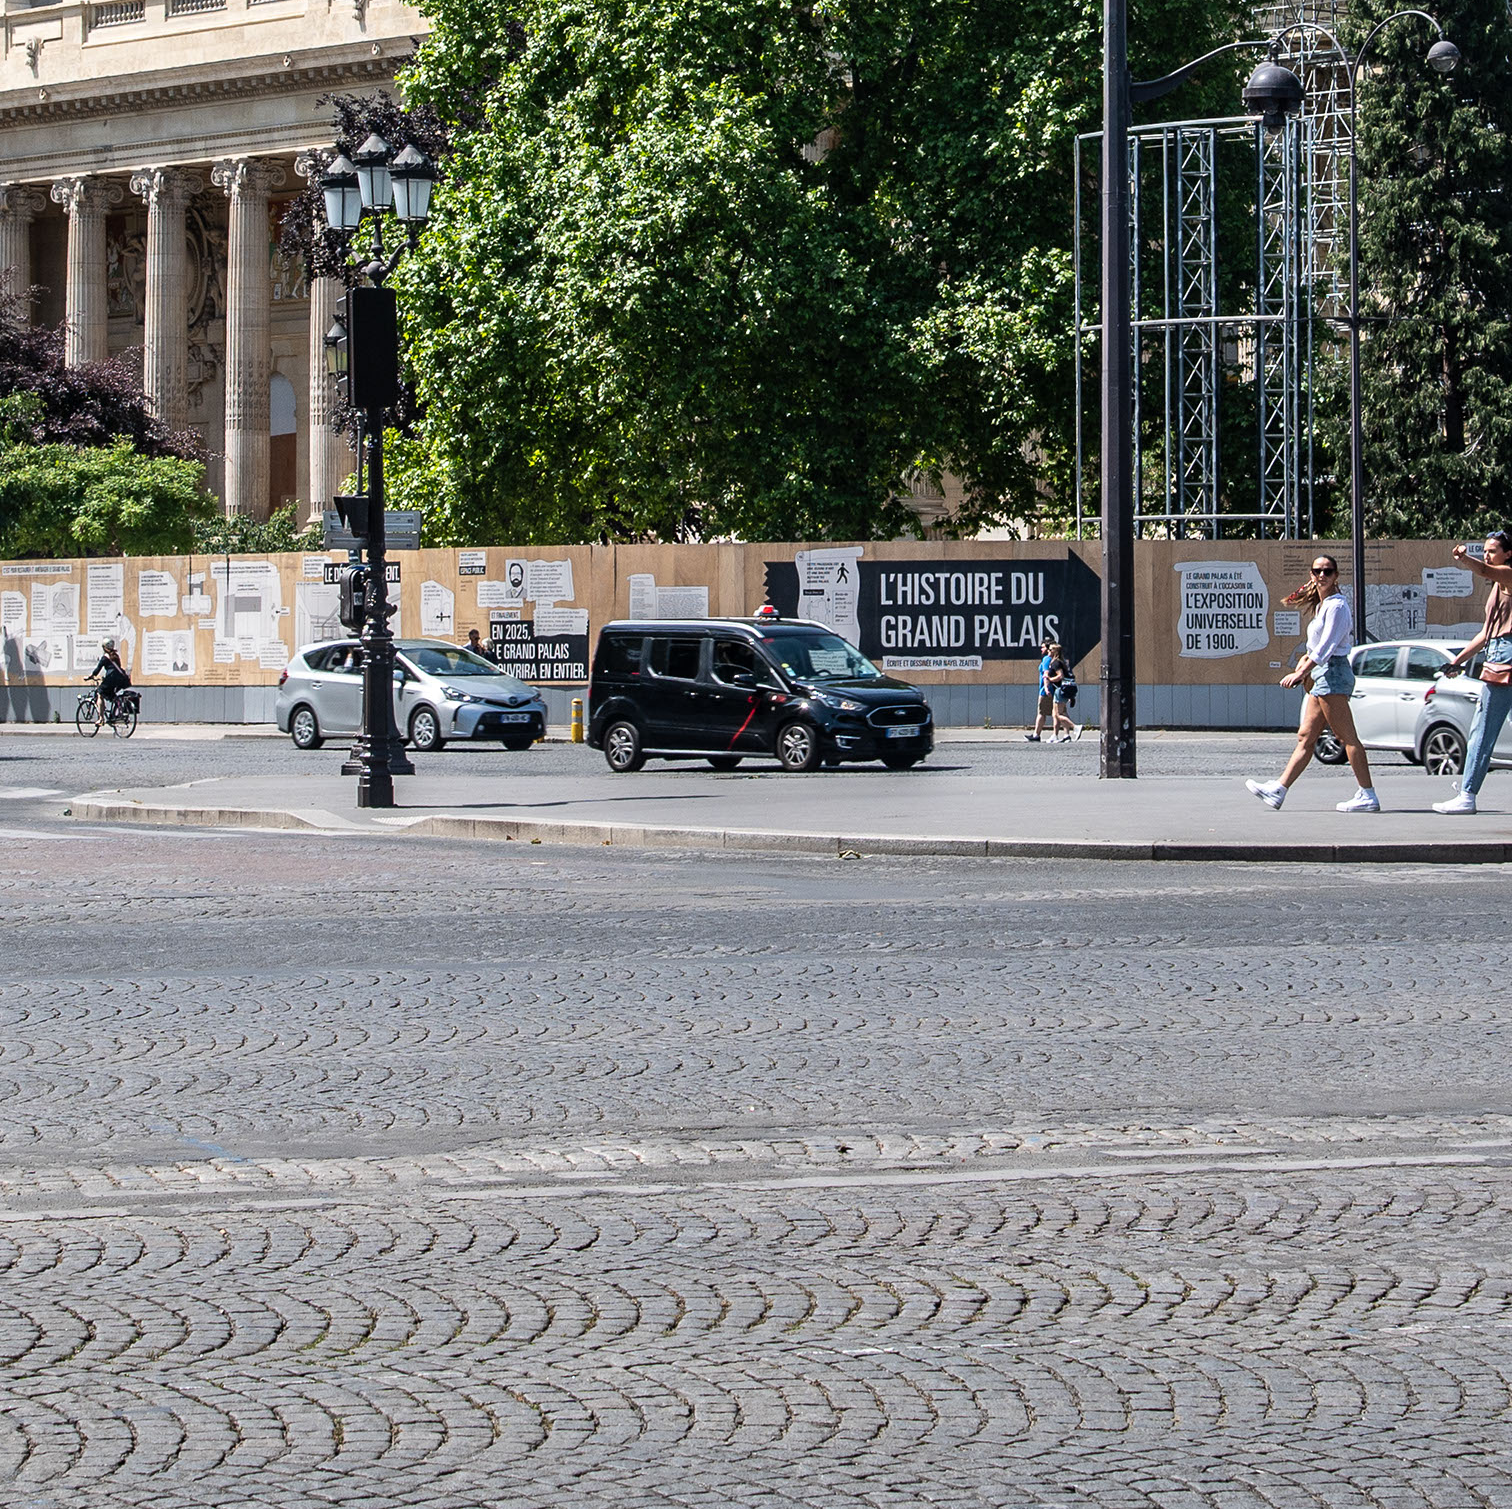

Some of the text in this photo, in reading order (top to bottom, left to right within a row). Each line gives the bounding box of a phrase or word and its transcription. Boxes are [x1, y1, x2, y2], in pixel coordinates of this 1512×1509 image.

[325, 567, 333, 582] LE
[1234, 572, 1242, 580] ÉTÉ
[880, 572, 1044, 606] L'HISTOIRE DU
[1214, 581, 1217, 589] À
[1186, 593, 1263, 609] L'EXPOSITION
[1186, 613, 1262, 629] UNIVERSELLE
[492, 624, 531, 640] EN 2025,
[880, 615, 1059, 648] GRAND PALAIS
[1187, 634, 1238, 649] DE 1900.
[504, 643, 535, 659] GRAND
[538, 643, 569, 659] PALAIS
[540, 663, 551, 678] EN
[554, 663, 587, 678] ENTIER.
[887, 659, 902, 667] ÉCRITE
[933, 659, 942, 667] PAR
